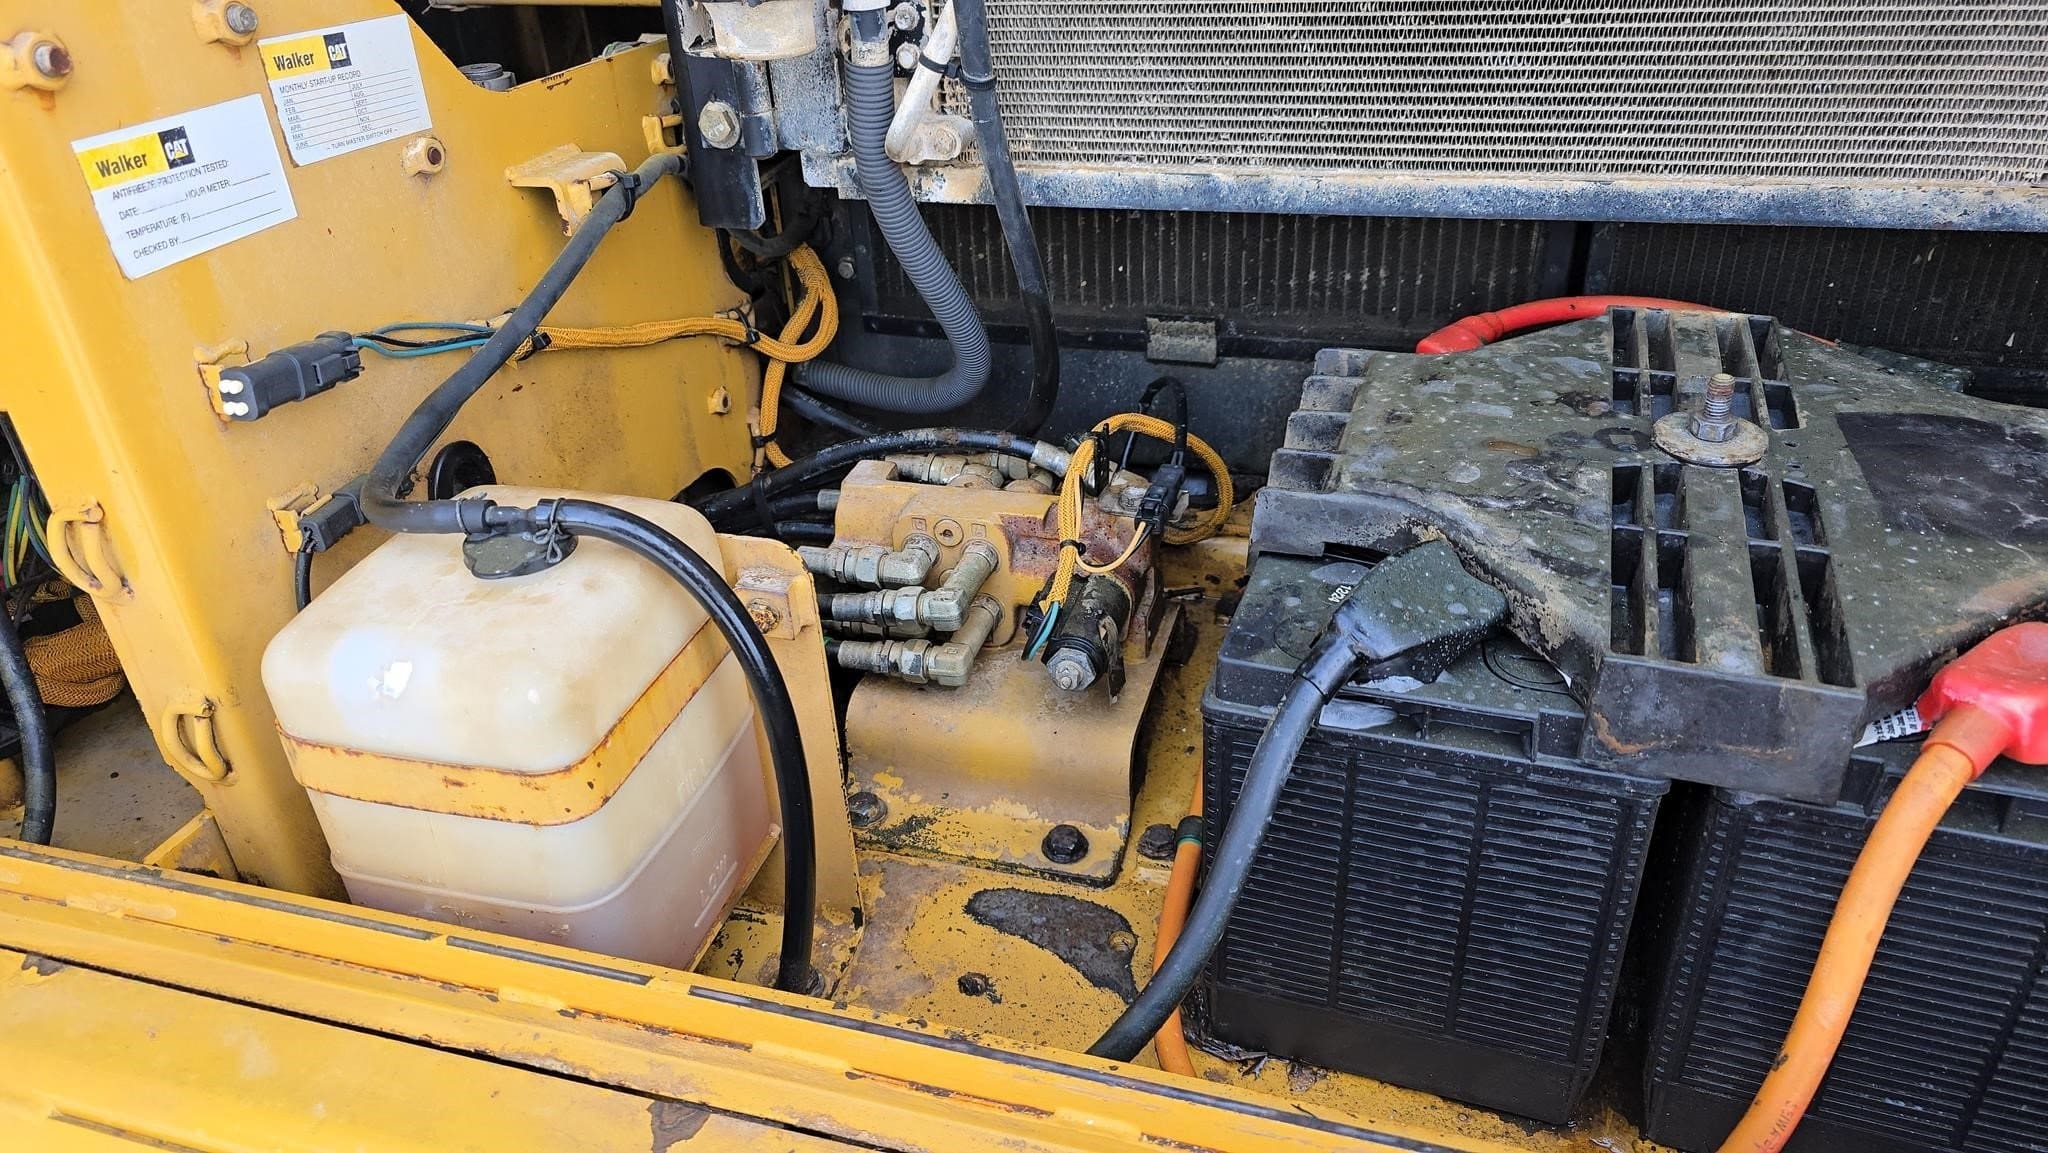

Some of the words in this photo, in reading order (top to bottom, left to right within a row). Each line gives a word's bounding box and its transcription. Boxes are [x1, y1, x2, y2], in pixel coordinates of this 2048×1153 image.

[273, 52, 314, 71] Walker
[328, 43, 347, 61] CAT
[279, 82, 307, 93] MONTHLY
[309, 76, 336, 87] START-UP
[337, 70, 361, 81] RECORD
[96, 153, 147, 178] Walker
[164, 138, 189, 161] CAT
[112, 180, 154, 200] ANTIFREEZE
[158, 167, 202, 184] PROTECTION
[186, 186, 206, 199] HOUR
[133, 240, 168, 259] CHECKED
